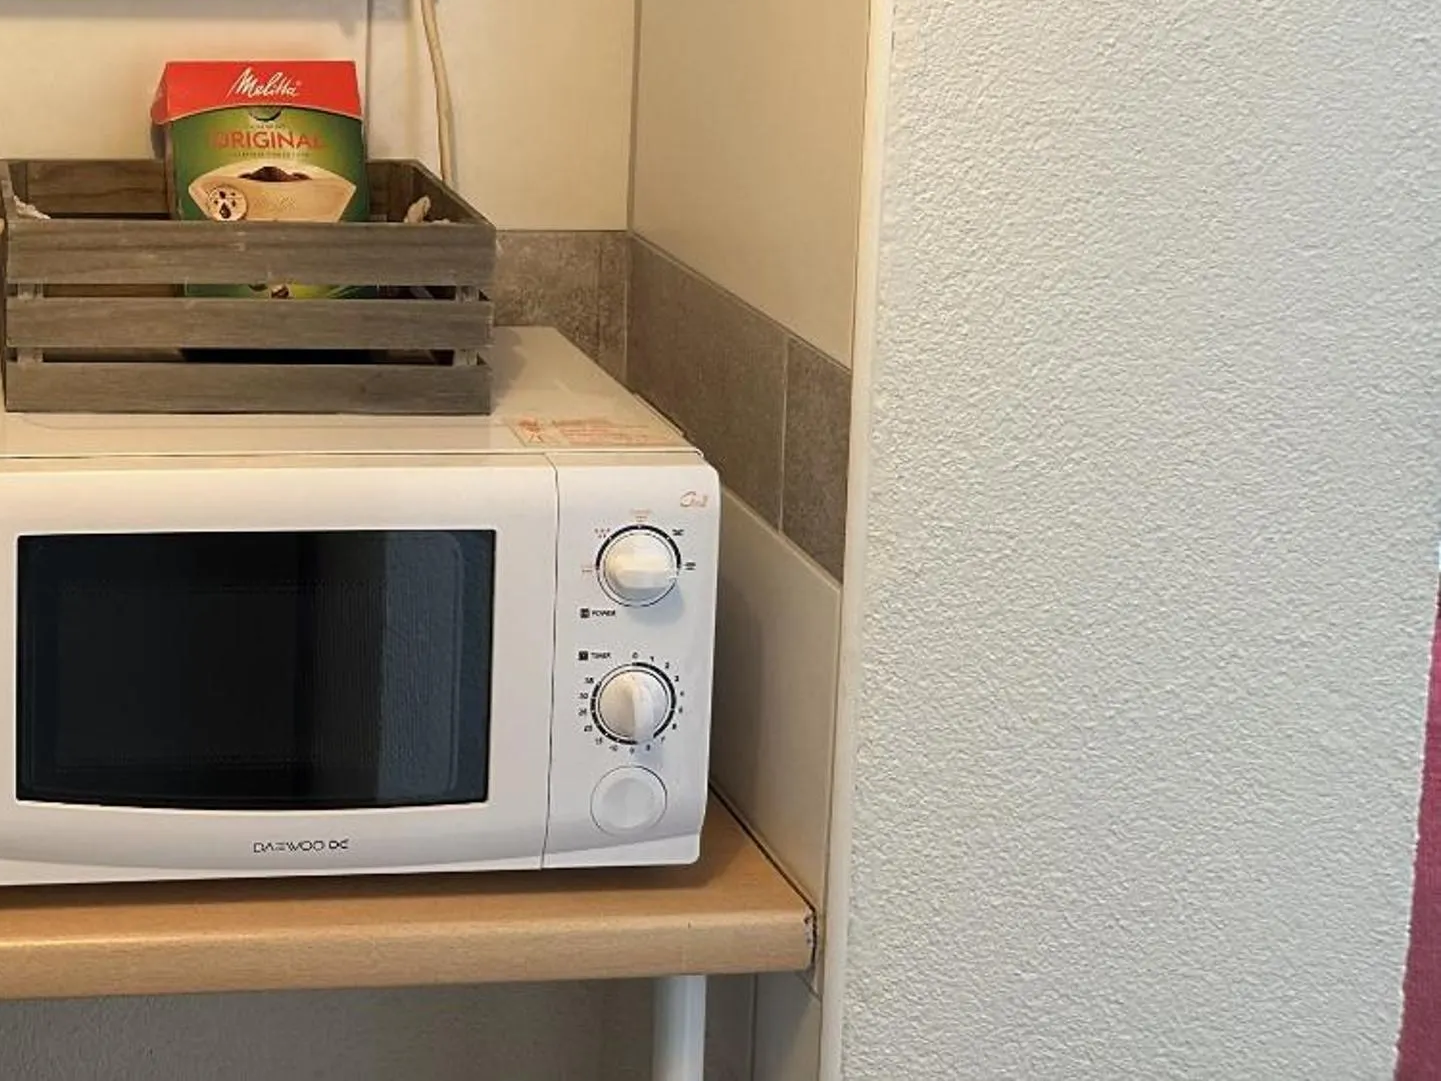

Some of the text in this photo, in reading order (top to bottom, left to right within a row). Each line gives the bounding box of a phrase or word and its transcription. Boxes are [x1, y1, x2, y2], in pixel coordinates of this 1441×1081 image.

[224, 66, 299, 102] Melitta
[213, 129, 326, 150] ORIGINAL
[253, 839, 326, 854] DAEWOO
